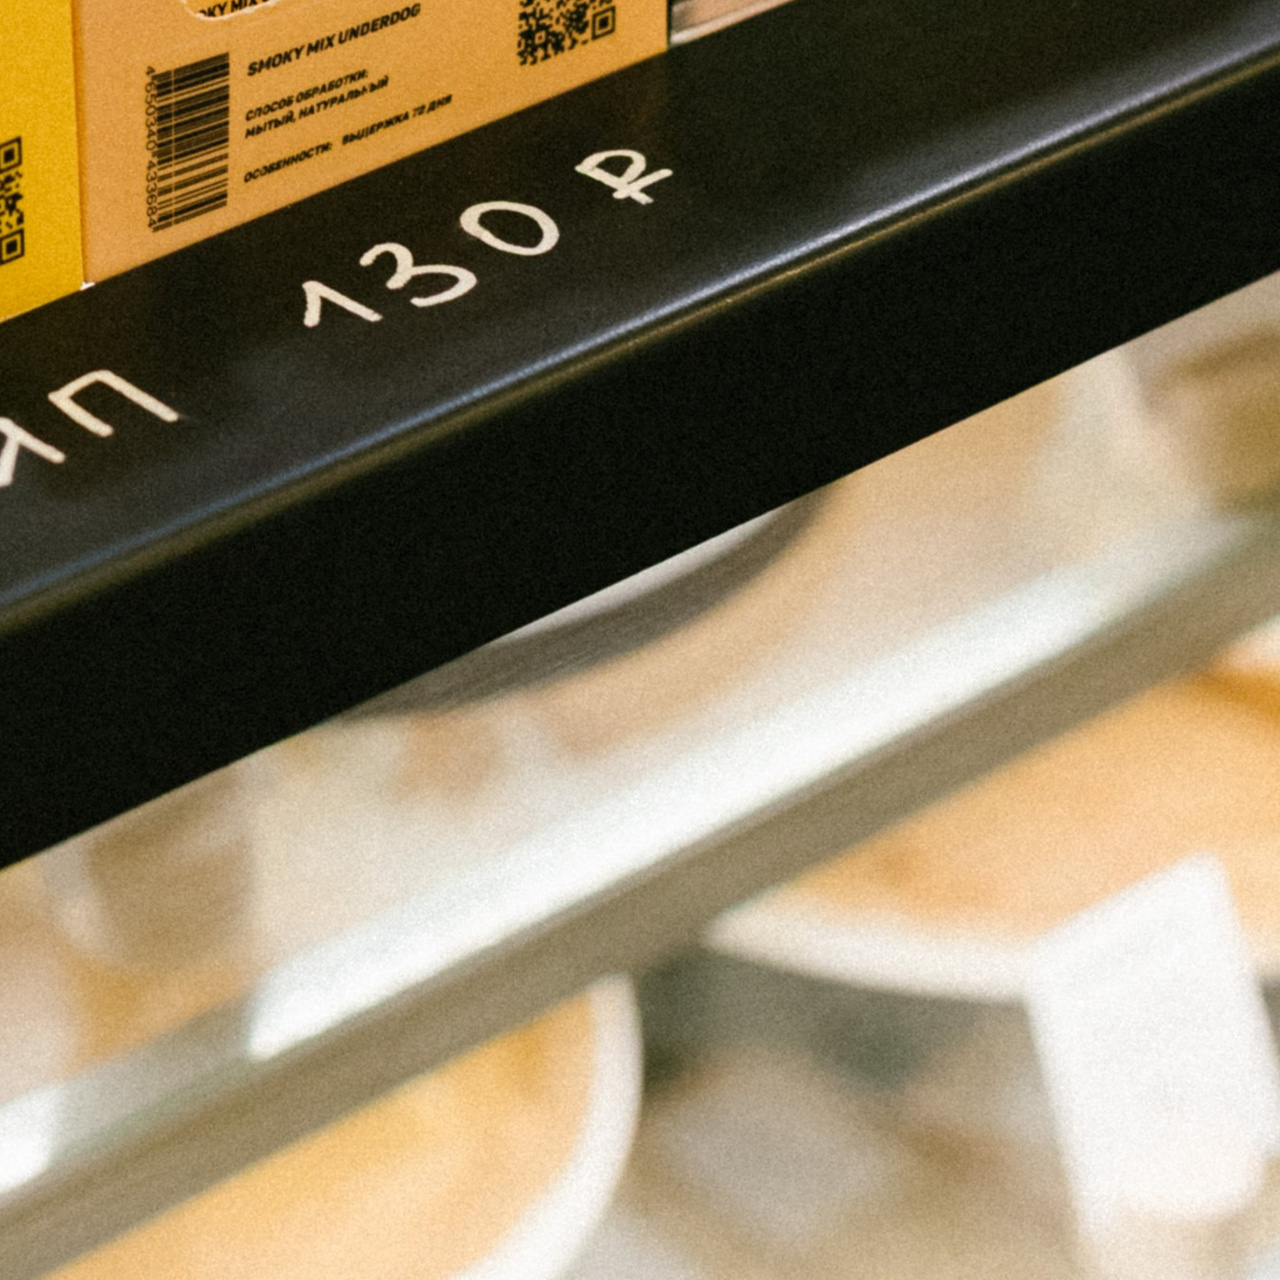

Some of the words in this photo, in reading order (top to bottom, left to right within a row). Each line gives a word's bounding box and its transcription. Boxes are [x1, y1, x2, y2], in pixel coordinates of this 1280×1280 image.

[247, 45, 306, 77] SMOKY
[307, 34, 336, 56] MIX
[338, 2, 422, 45] UNDERDOG
[245, 96, 295, 122] СПОСОБ
[296, 68, 369, 104] ОБРАБОТКИ:
[245, 112, 296, 139] МЫТЫЙ,
[244, 141, 333, 183] ОСОБЕННОСТИ:
[146, 160, 158, 229] 433684
[300, 200, 560, 330] 130
